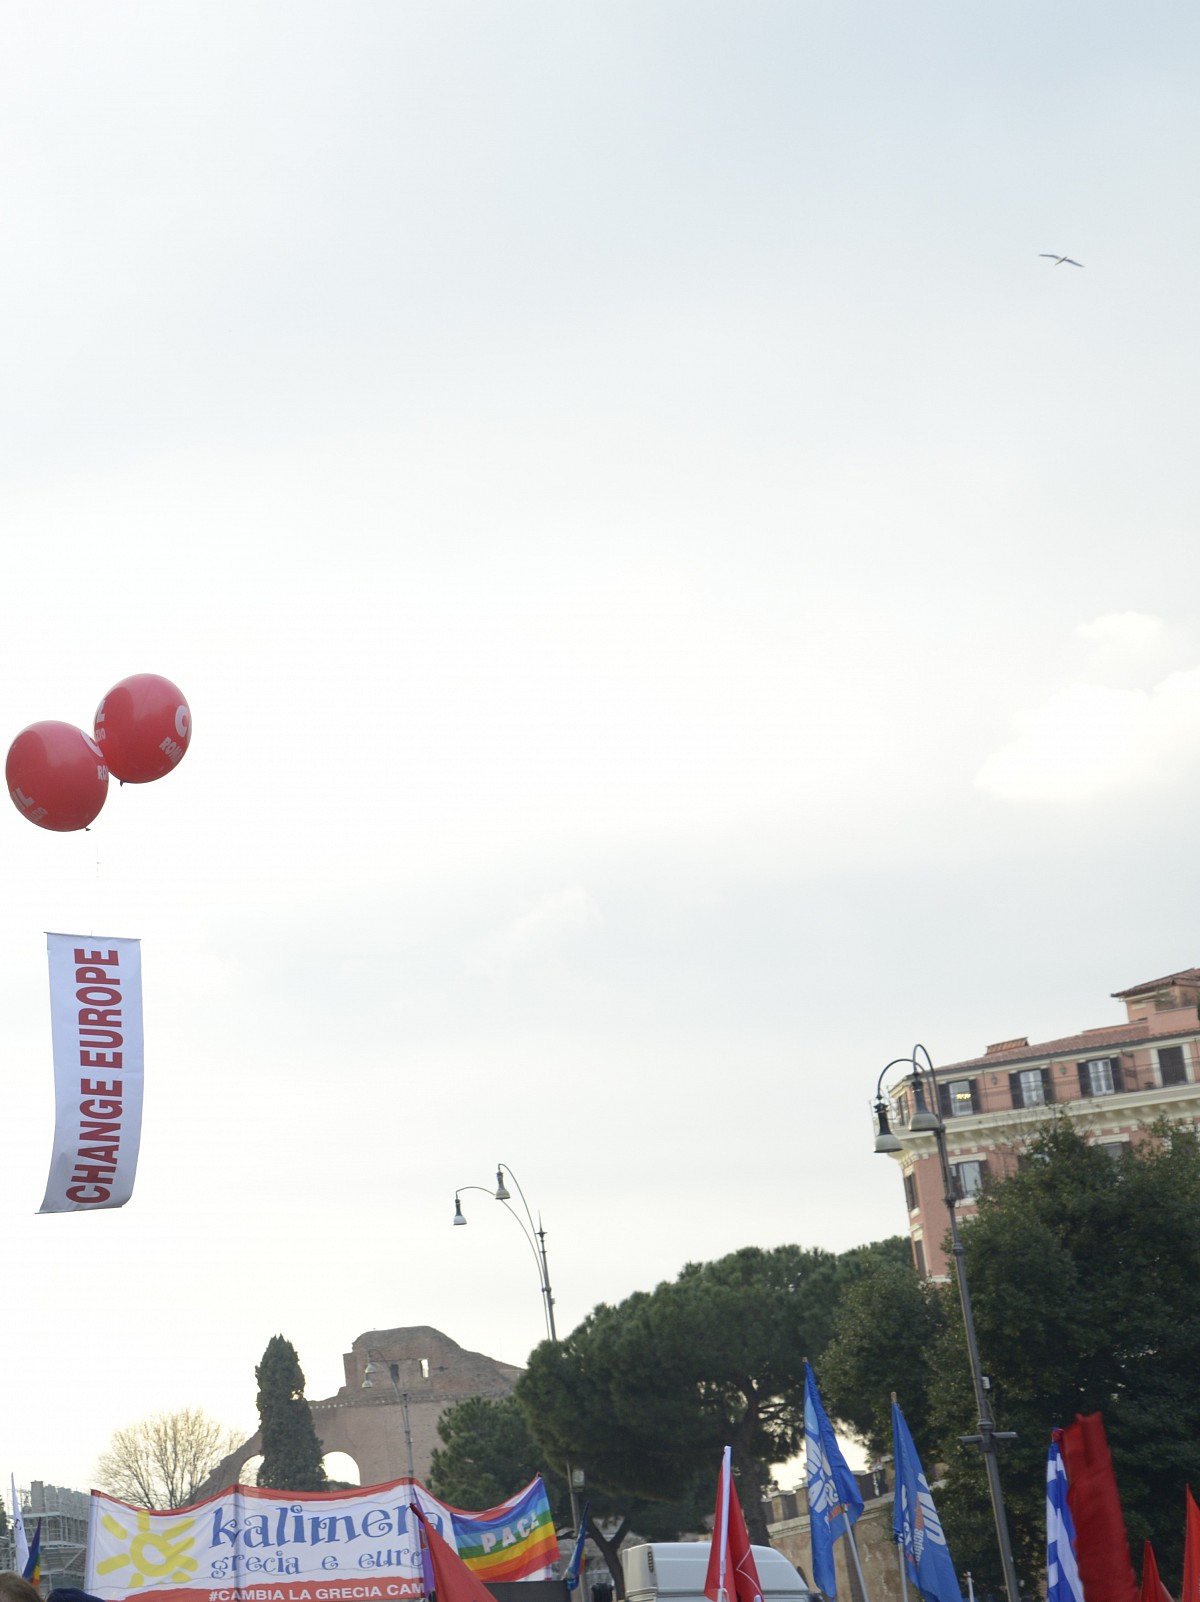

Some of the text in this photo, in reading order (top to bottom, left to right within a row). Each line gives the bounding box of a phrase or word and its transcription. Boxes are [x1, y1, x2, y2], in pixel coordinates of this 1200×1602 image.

[65, 948, 124, 1204] CHANGE EUROPE
[210, 1550, 301, 1579] grecia
[321, 1555, 339, 1570] e
[209, 1589, 285, 1602] #CAMBIA
[289, 1589, 312, 1600] LA
[315, 1586, 383, 1599] GRECIA
